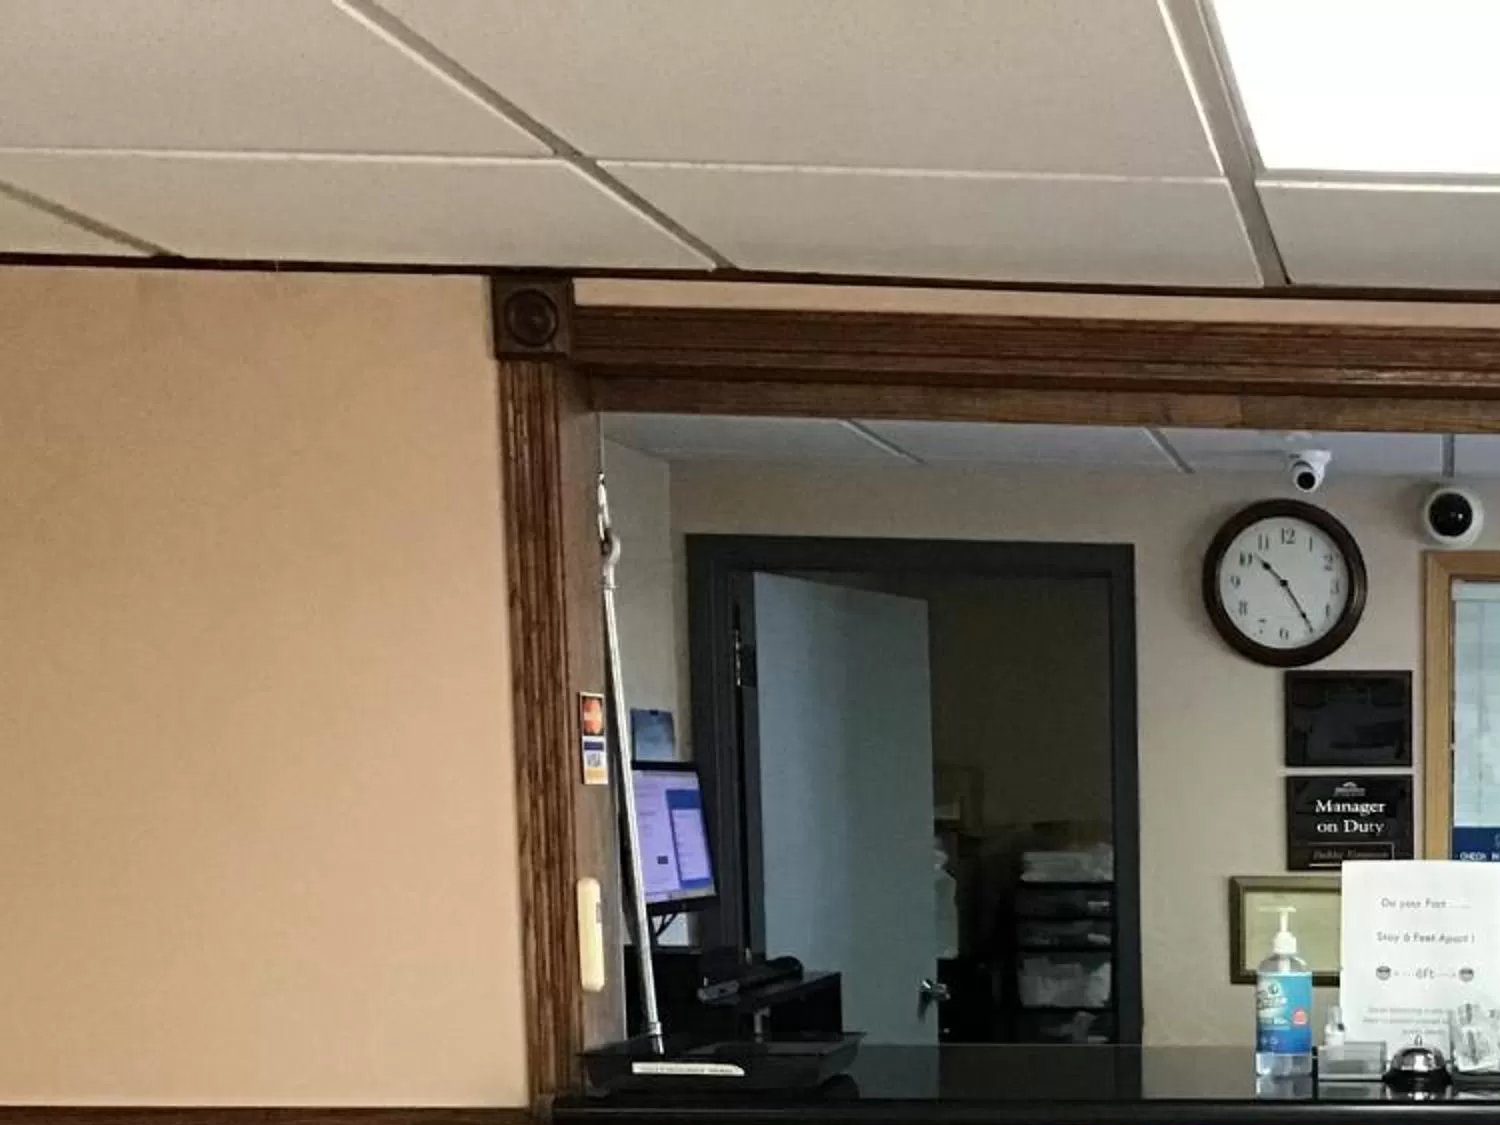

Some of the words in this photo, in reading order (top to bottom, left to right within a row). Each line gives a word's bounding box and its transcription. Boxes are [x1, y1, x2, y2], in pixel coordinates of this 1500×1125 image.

[1281, 527, 1296, 545] 12
[1315, 799, 1387, 817] Manager
[1316, 821, 1339, 833] on
[1343, 819, 1385, 837] Duty
[1376, 931, 1400, 944] Stay
[1413, 931, 1436, 943] Feet
